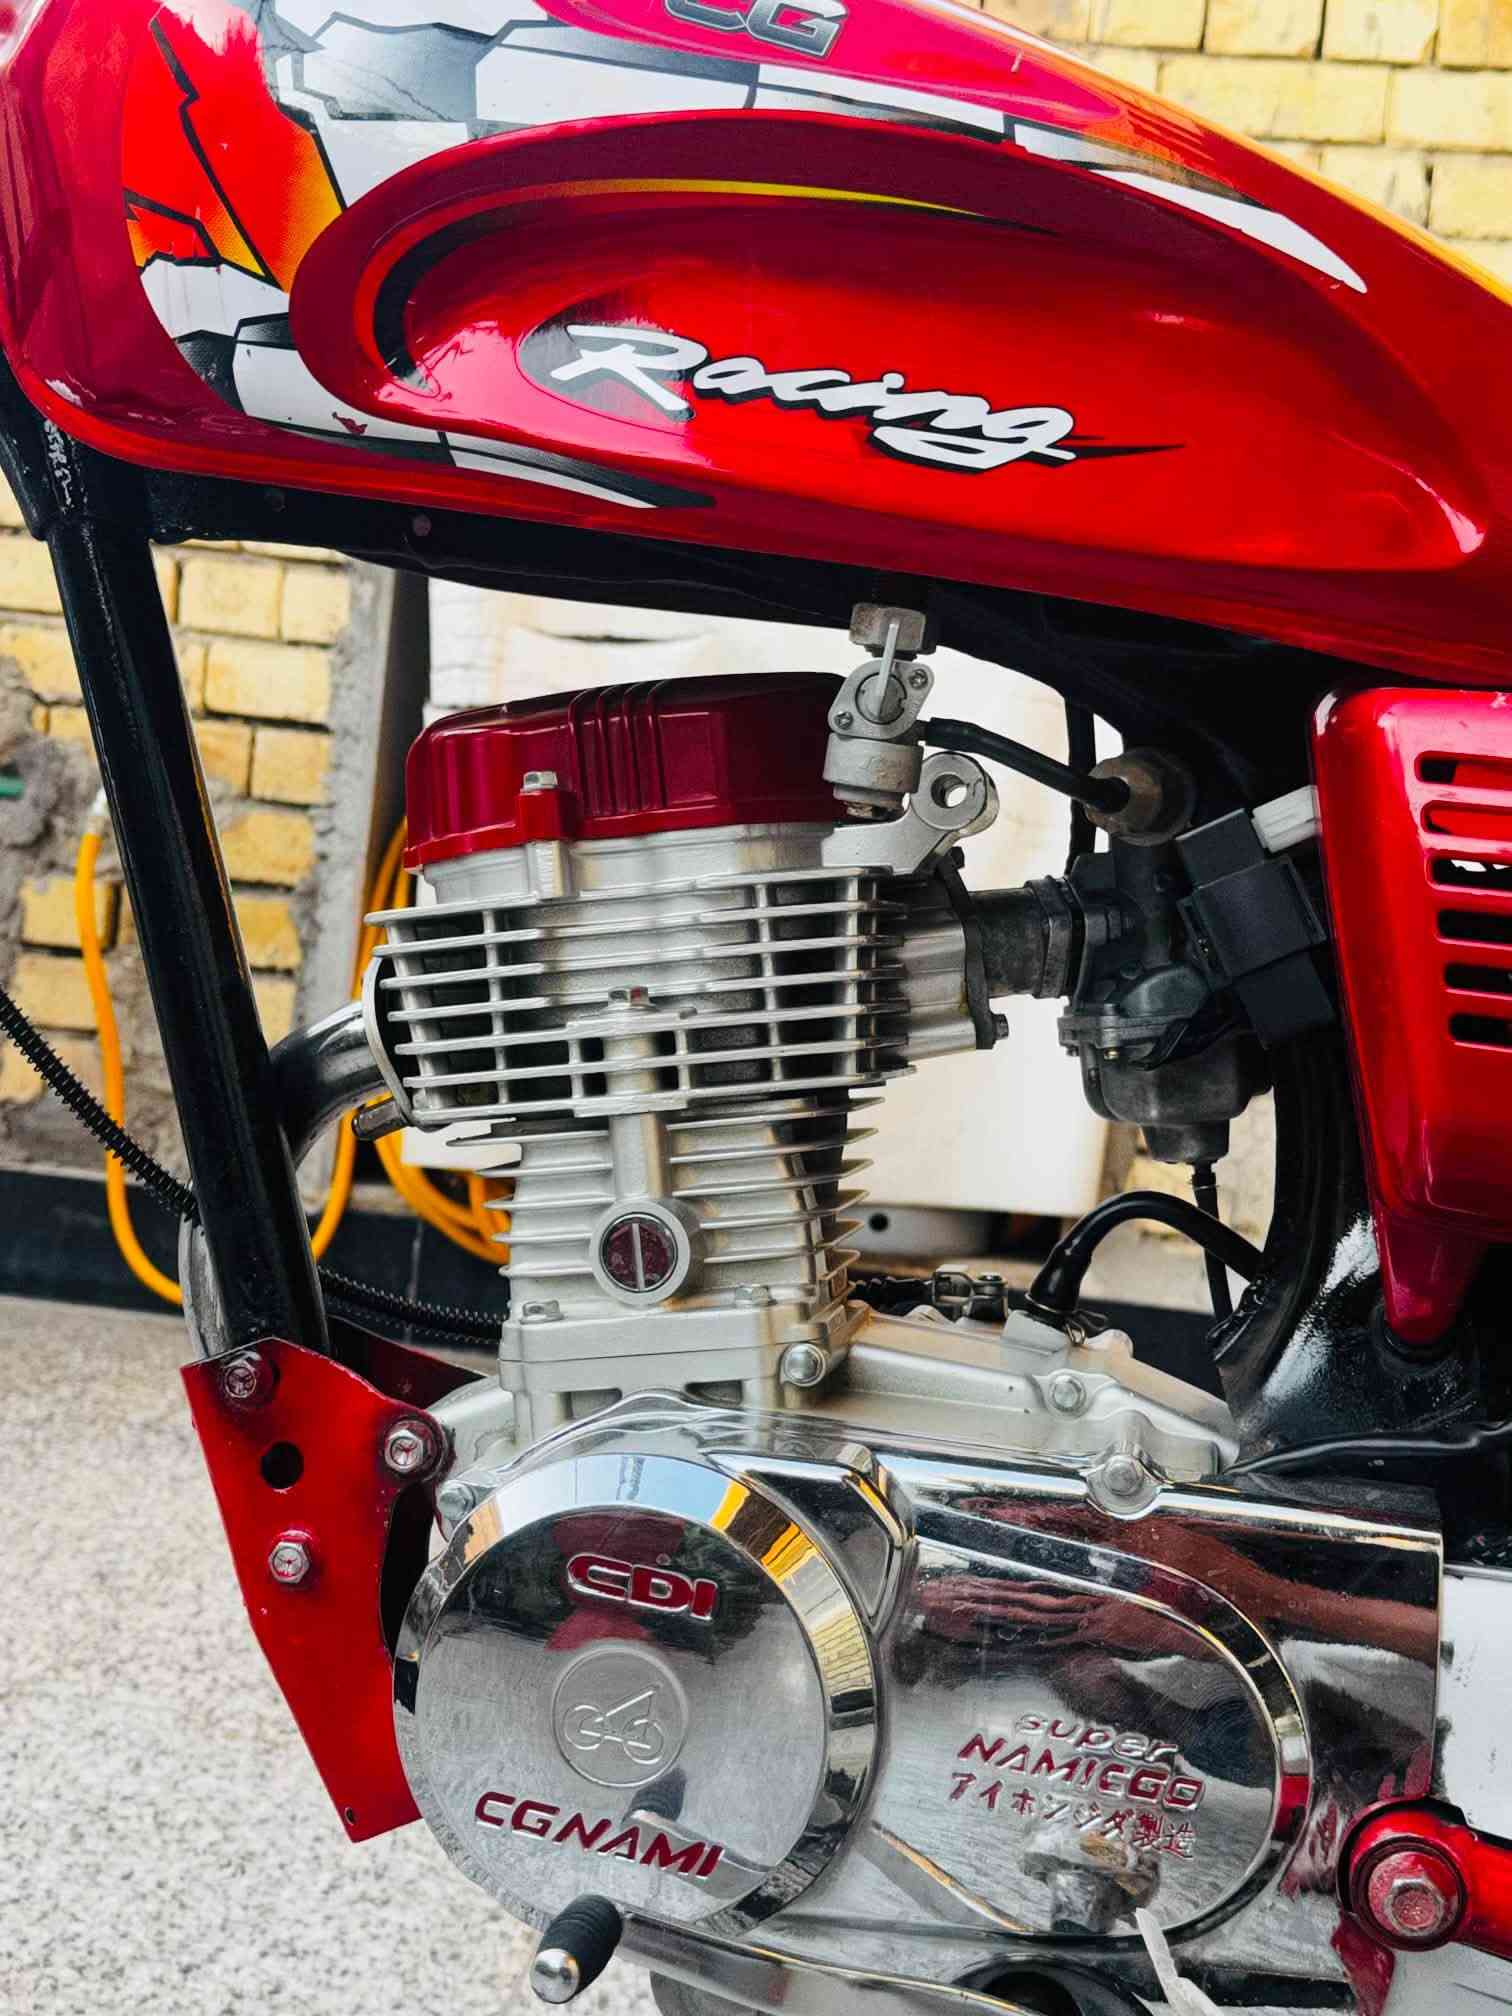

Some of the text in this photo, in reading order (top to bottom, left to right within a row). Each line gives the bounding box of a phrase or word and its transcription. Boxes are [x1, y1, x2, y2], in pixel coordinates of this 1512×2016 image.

[664, 0, 848, 57] CG
[550, 323, 1078, 472] Racing
[566, 1552, 718, 1620] CDI
[473, 1790, 725, 1880] CGNAMI
